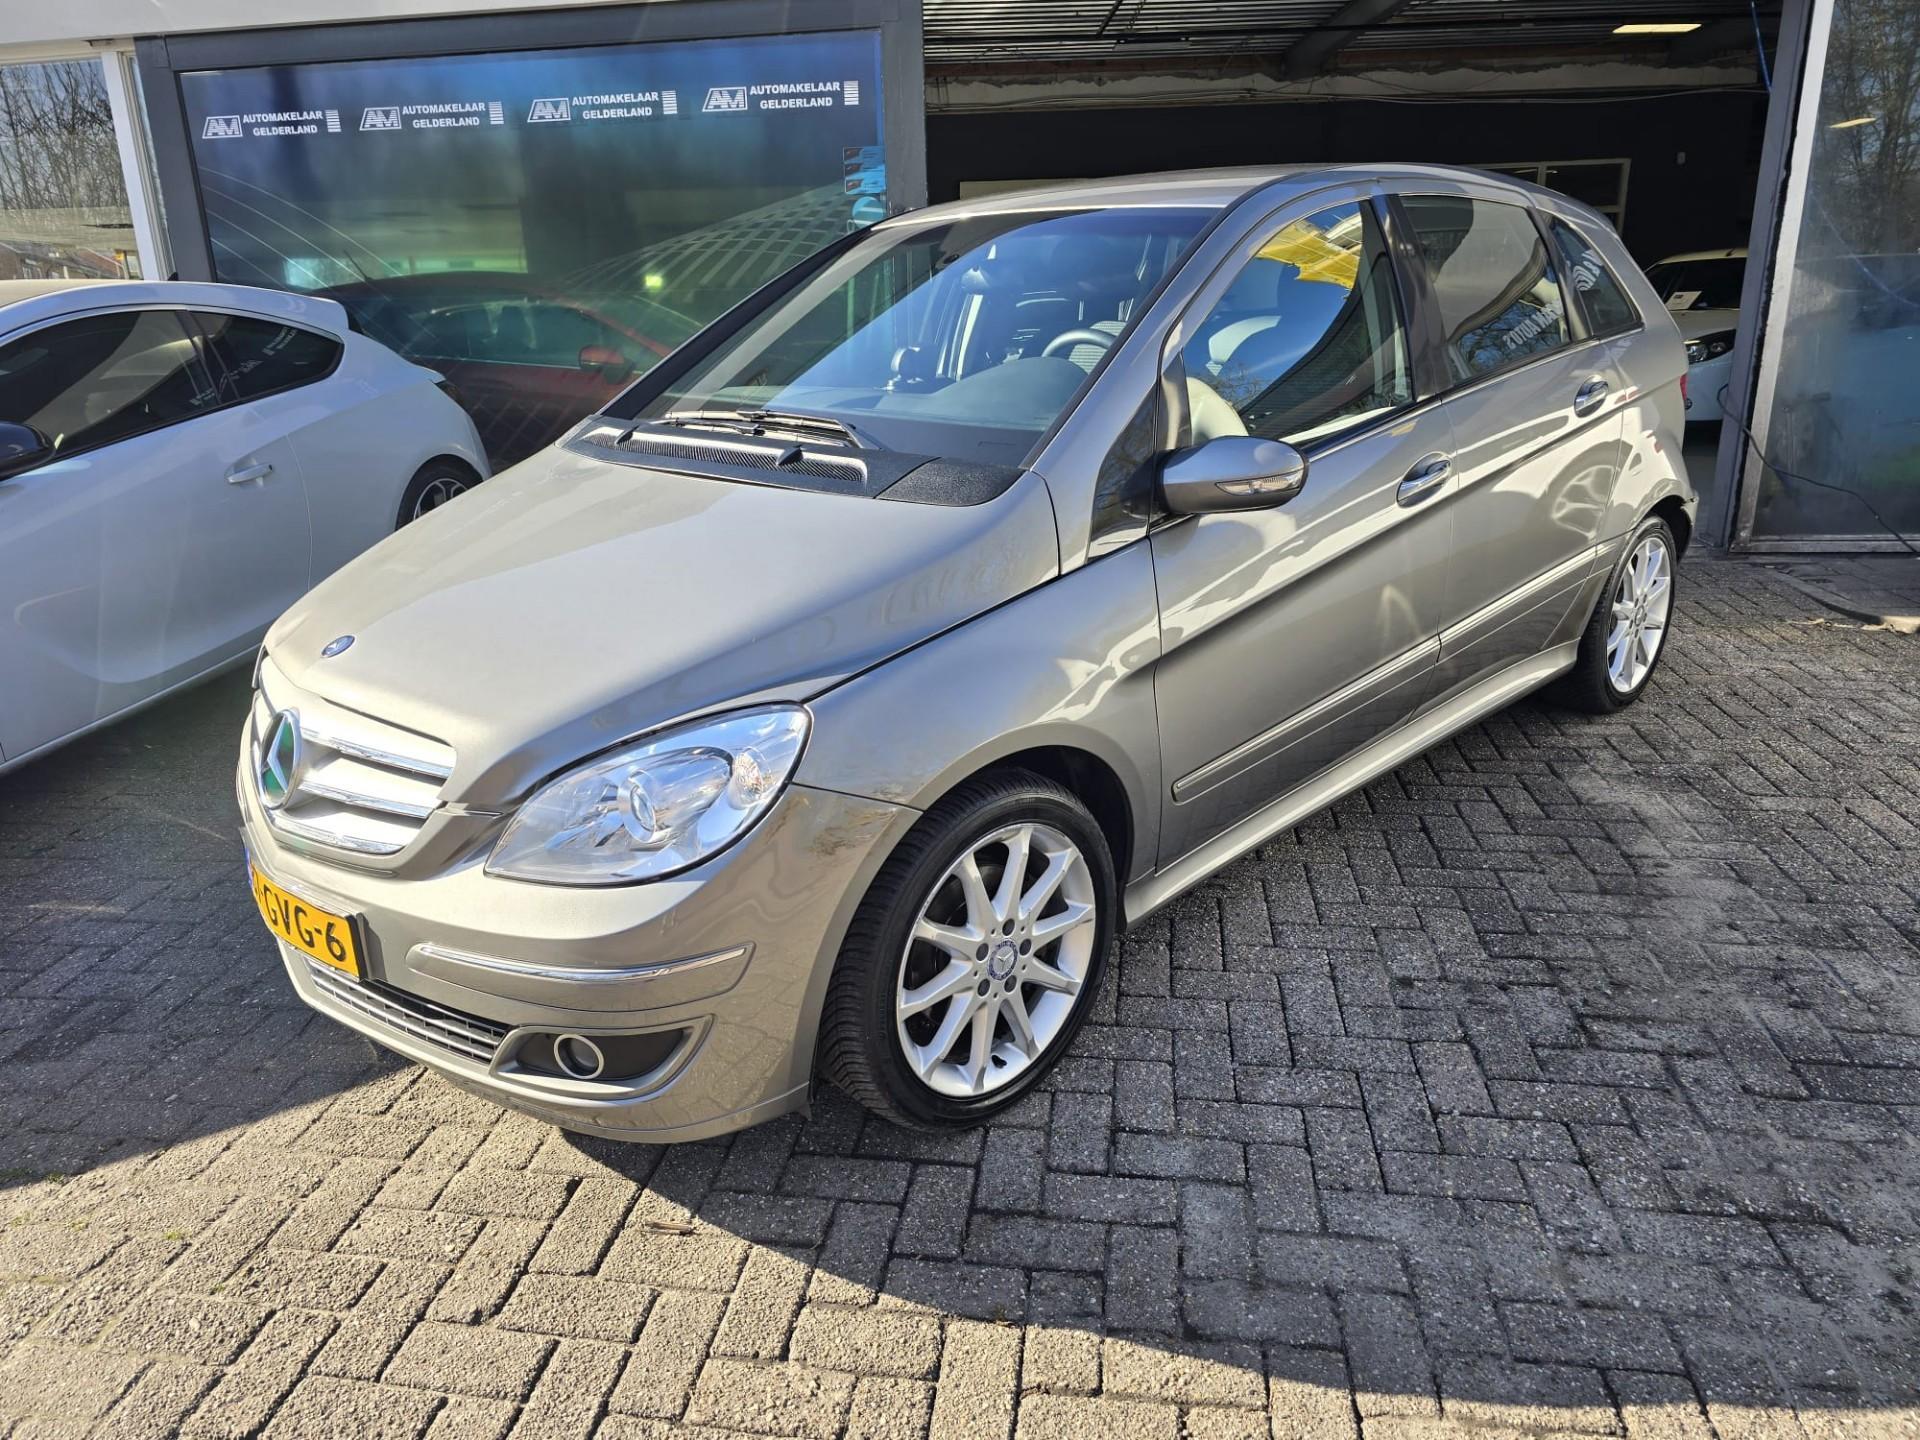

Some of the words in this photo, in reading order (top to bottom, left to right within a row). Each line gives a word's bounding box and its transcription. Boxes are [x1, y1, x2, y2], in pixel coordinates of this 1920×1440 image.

[750, 81, 841, 95] AUTOMAKELAAR
[572, 91, 660, 106] AUTOMAKELAAR
[760, 97, 833, 110] GELDERLAND
[402, 102, 486, 115] AUTOMAKELAAR
[582, 107, 653, 119] GELDERLAND
[243, 110, 323, 123] AUTOMAKELAAR
[412, 116, 480, 128] GELDERLAND
[252, 124, 318, 137] GELDERLAND
